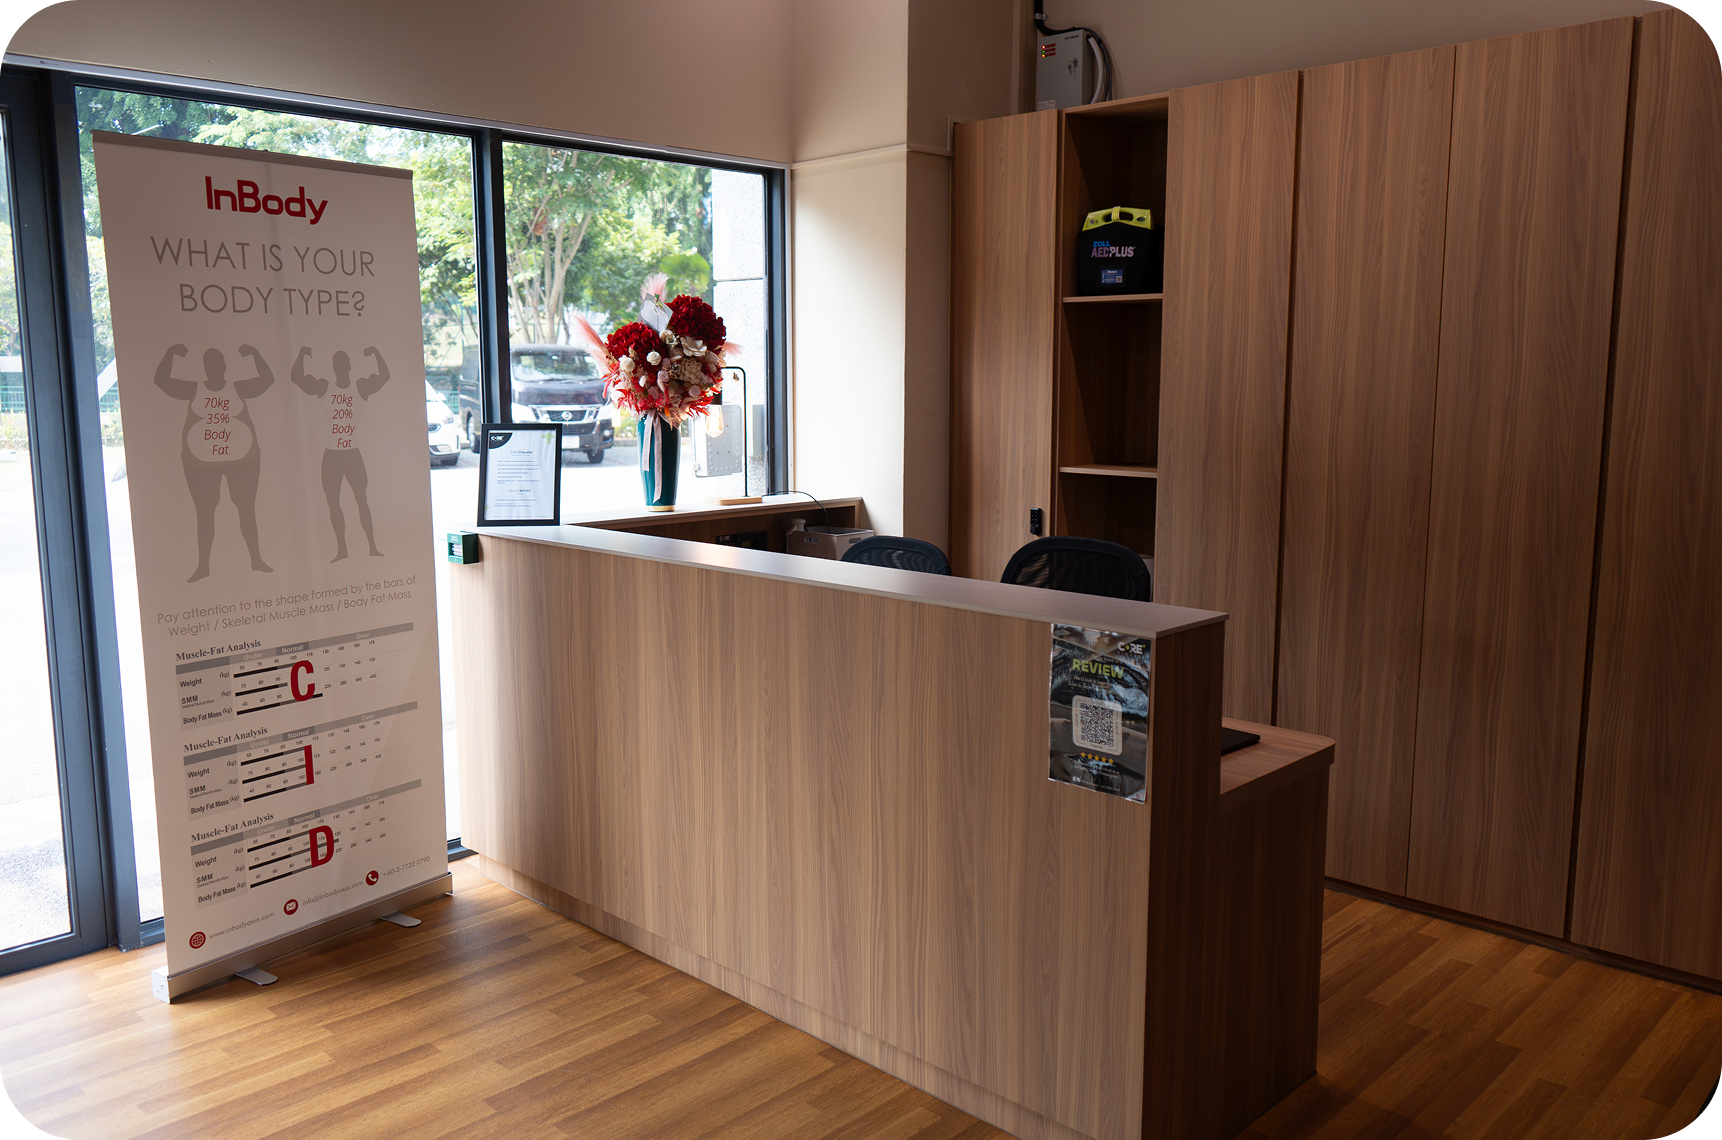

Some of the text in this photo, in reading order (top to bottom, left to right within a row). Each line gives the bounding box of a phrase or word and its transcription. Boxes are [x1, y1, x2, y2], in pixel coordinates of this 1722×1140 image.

[205, 176, 328, 224] InBody
[150, 236, 374, 277] WHAT IS YOUR
[180, 284, 365, 317] BODY TYPE?
[204, 398, 229, 410] 70kg
[331, 394, 353, 407] 70kg
[206, 413, 229, 424] 35%
[333, 409, 353, 419] 20%
[204, 428, 231, 442] Body
[332, 423, 355, 435] Body
[212, 445, 229, 455] Fat
[337, 438, 351, 448] Fat
[158, 576, 417, 624] Pay attention to the shape formed by the bars of
[168, 591, 412, 637] Weight / Skeletal Muscle Mass / Body Fat Mass
[176, 640, 261, 661] Muscle-Fat Analysis
[282, 645, 303, 653] Normal
[1073, 658, 1124, 679] REVIEW
[180, 678, 202, 687] Weight
[290, 660, 315, 701] C
[182, 695, 198, 704] SMM
[184, 727, 268, 752] Muscle-Fat Analysis
[251, 740, 270, 748] Under
[288, 730, 309, 739] Normal
[188, 768, 210, 778] Weight
[189, 785, 206, 794] SMM
[191, 806, 205, 814] Body
[215, 799, 229, 808] Mass
[191, 813, 274, 842] Muscle-Fat Analysis
[257, 825, 275, 834] Under
[294, 813, 315, 823] Normal
[309, 825, 334, 868] D
[195, 857, 217, 867] Weight
[383, 856, 431, 877] +60-3-7732 0790
[197, 874, 213, 883] SMM
[198, 894, 212, 903] Body
[303, 881, 363, 906] info@inbodyasia.com
[209, 913, 274, 939] www.inbodyasia.com
